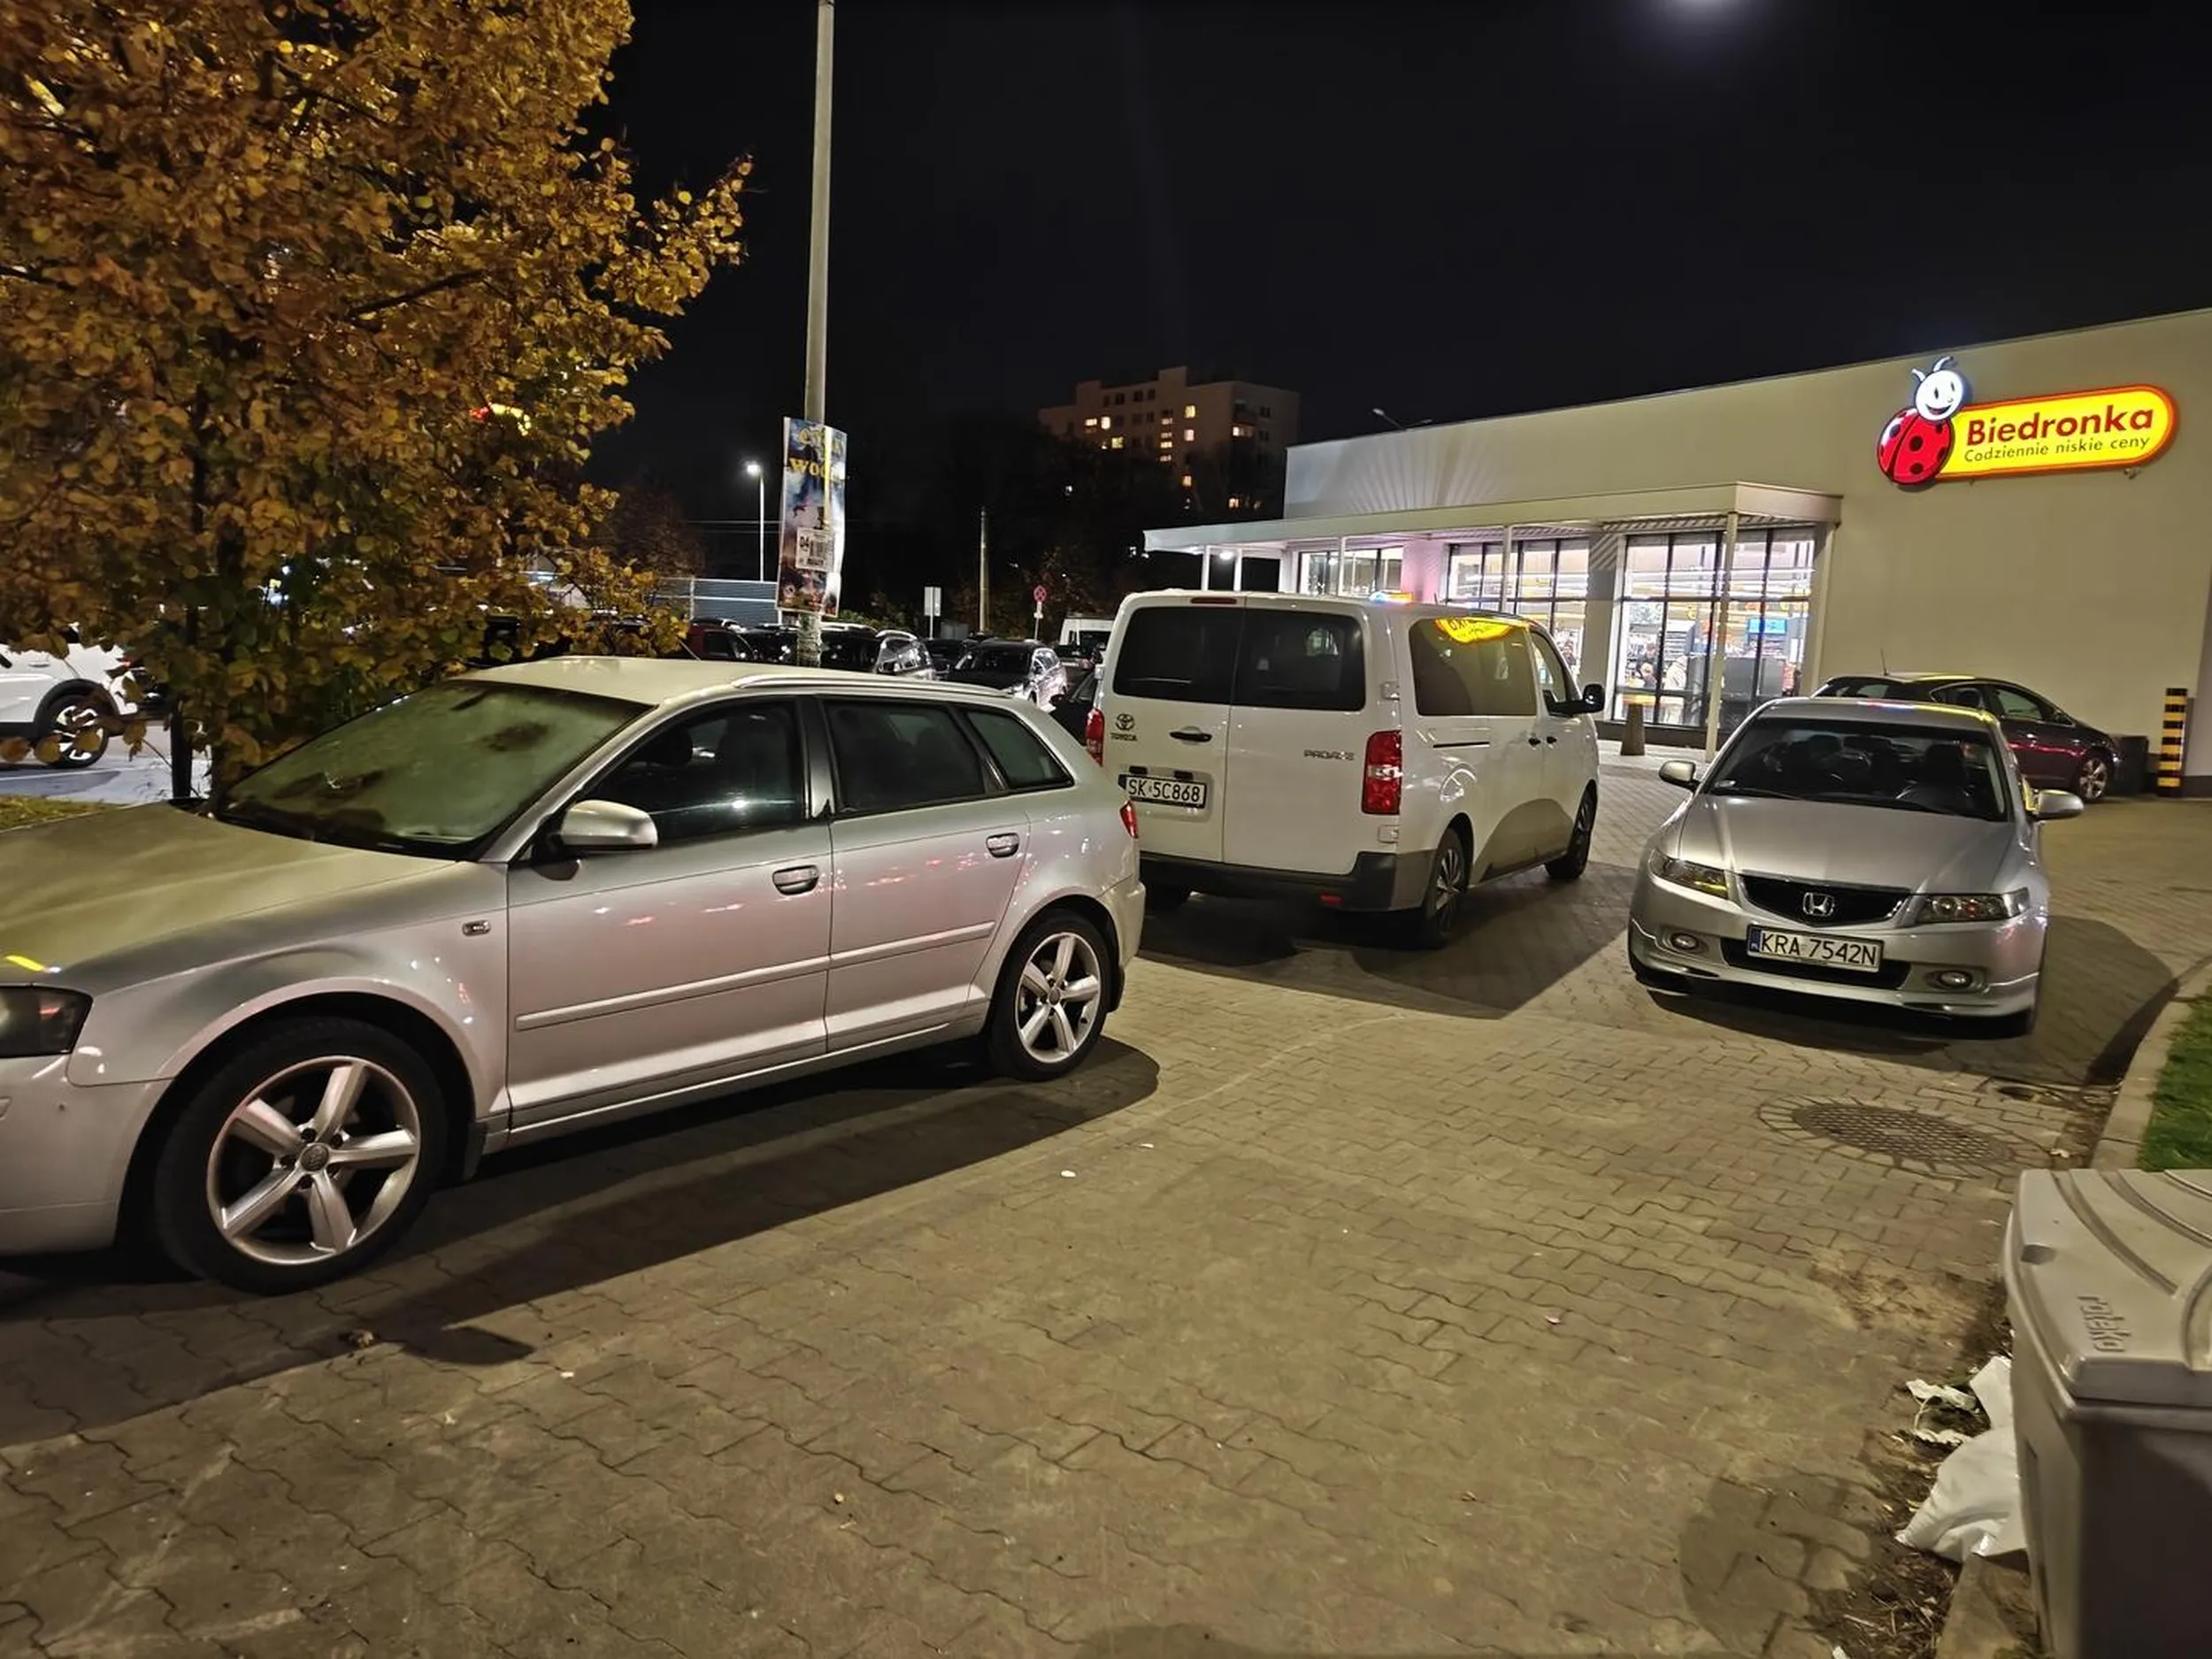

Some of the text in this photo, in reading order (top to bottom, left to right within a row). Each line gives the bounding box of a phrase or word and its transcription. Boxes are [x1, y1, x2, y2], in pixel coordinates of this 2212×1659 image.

[1966, 404, 2154, 447] Biedronka
[1963, 436, 2150, 463] Codziennie niskie ceny
[1128, 778, 1201, 803] SK 5C868
[1762, 933, 1877, 965] KRA 7542N
